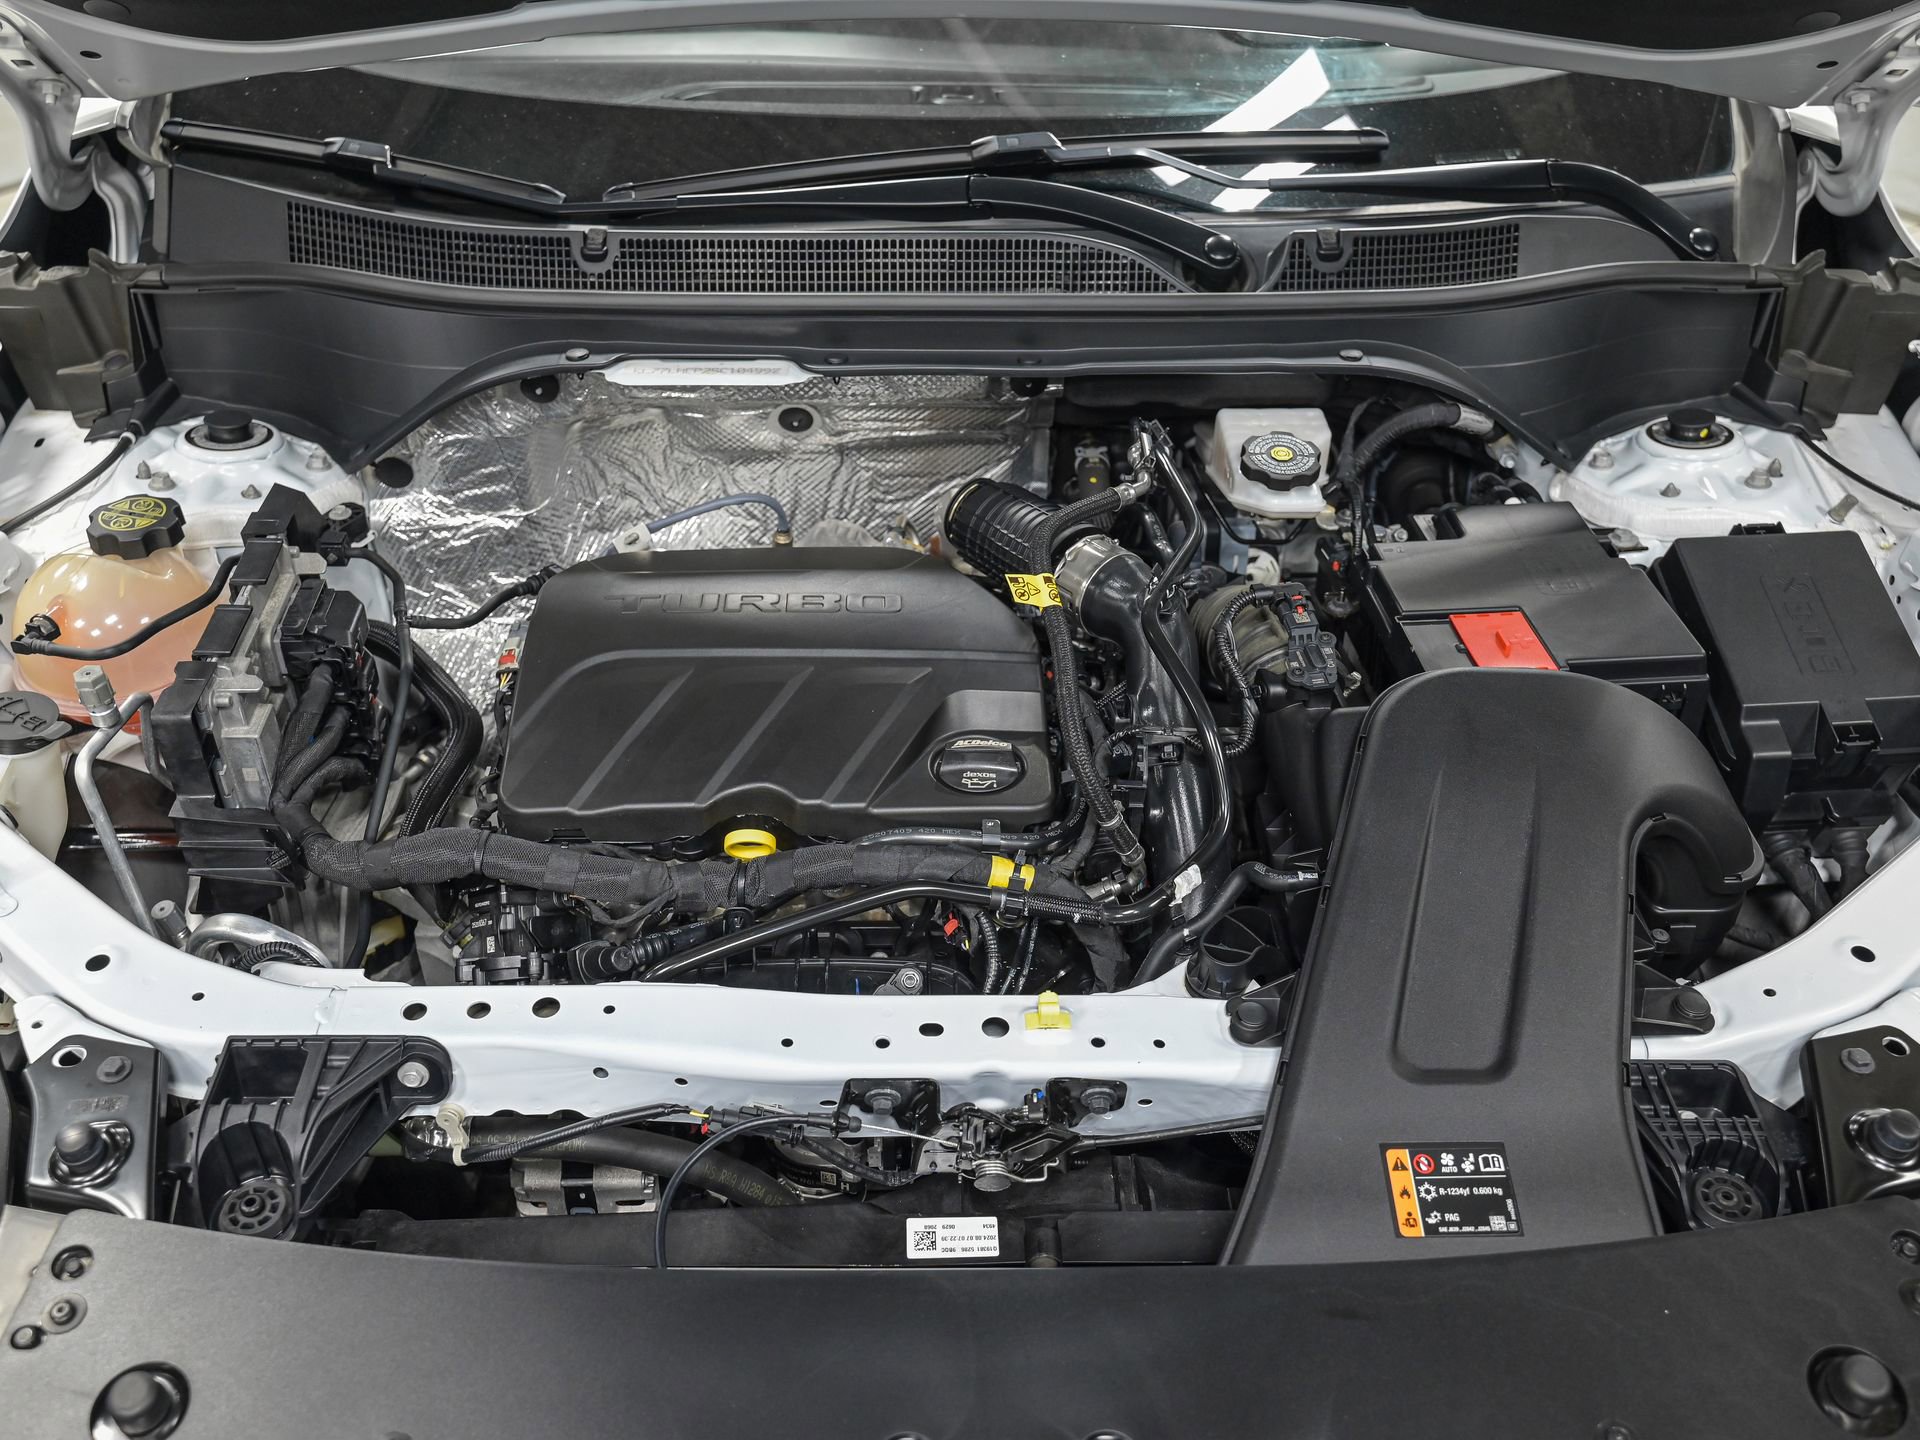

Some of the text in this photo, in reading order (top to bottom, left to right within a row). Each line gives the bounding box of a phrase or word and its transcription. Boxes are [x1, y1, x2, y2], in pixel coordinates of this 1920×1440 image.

[605, 593, 902, 614] TURBO
[1439, 1186, 1503, 1198] R-1234yf 0.600 kg
[1444, 1213, 1460, 1222] PAG
